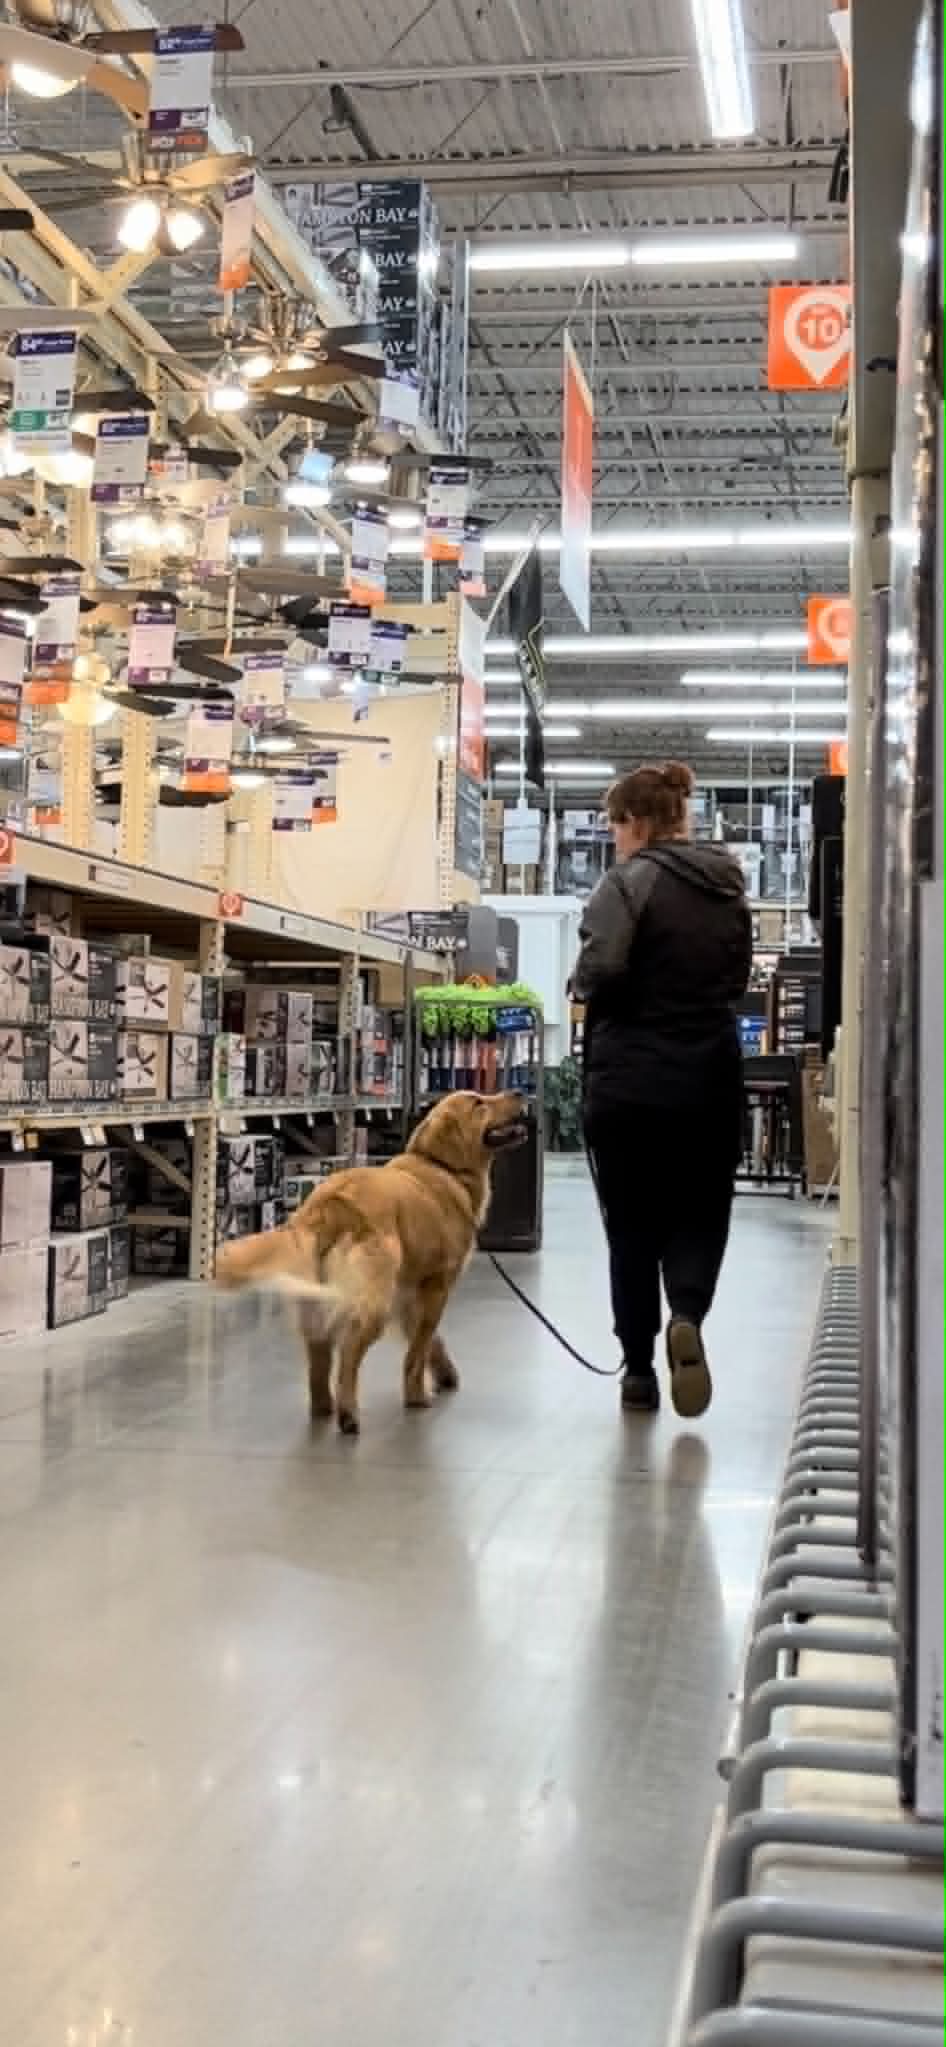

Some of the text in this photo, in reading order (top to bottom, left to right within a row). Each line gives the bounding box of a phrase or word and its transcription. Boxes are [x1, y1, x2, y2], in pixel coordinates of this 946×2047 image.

[375, 208, 406, 223] BAY
[375, 252, 406, 266] BAY
[803, 317, 840, 344] 10
[378, 339, 405, 354] AY
[426, 935, 456, 950] BAY
